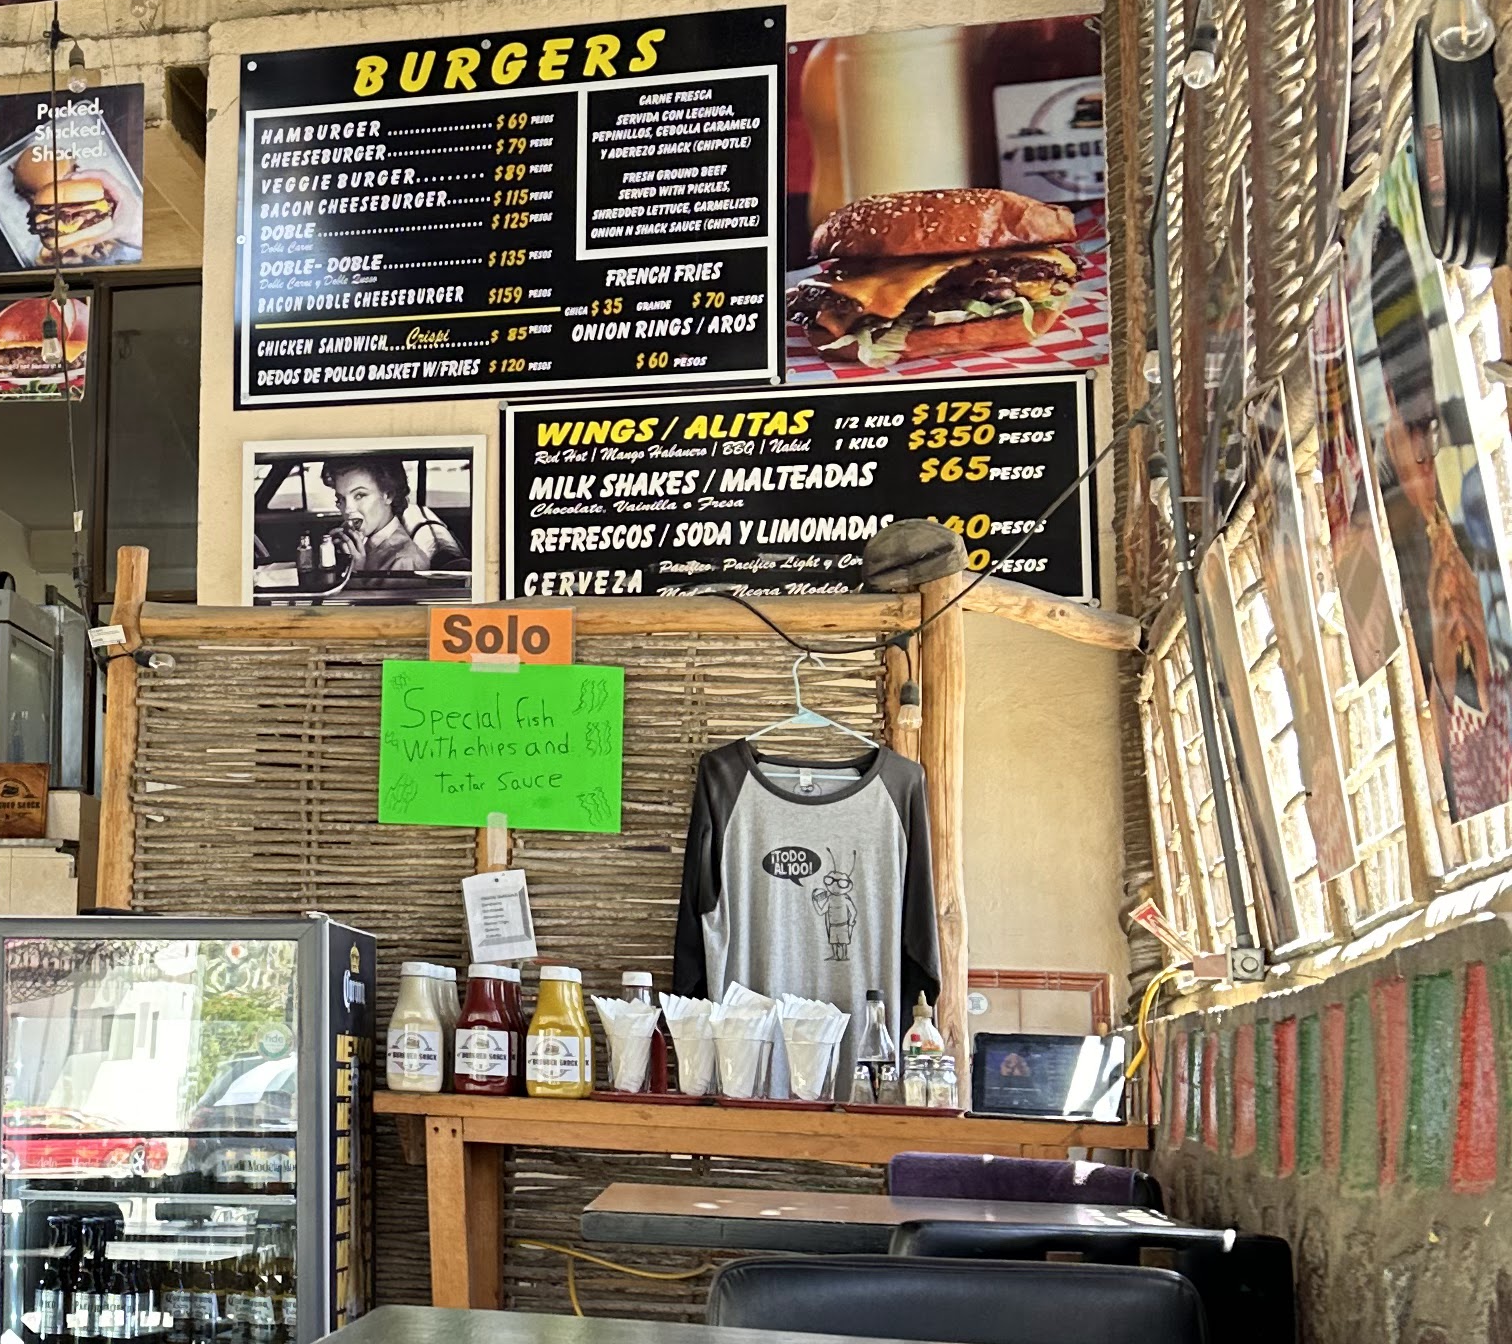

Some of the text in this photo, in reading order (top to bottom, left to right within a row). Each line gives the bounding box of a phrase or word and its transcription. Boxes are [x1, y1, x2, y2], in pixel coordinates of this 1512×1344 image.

[353, 27, 667, 98] BURGERS
[37, 97, 104, 120] Packed.
[639, 89, 712, 106] CARNE FRESCA
[34, 118, 106, 140] Stacked.
[616, 111, 660, 126] SERVIDA
[661, 108, 684, 122] CON
[656, 123, 701, 138] CEBOLLA
[702, 118, 760, 132] CARAMELO
[260, 120, 381, 144] HAMBURGER
[32, 139, 106, 162] Shacked.
[260, 144, 386, 169] CHEESEBURGER
[608, 144, 656, 160] ADEREZO
[656, 142, 692, 155] SHACK
[693, 136, 752, 152] (CHIPOTLE)
[261, 174, 332, 194] VEGGIE
[337, 168, 416, 190] BURGER
[622, 164, 728, 184] FRESH GROUND BEEF
[618, 186, 657, 200] SERVED
[659, 184, 686, 197] WITH
[260, 190, 448, 220] BACON CHEESEBURGER
[592, 206, 644, 220] SHREDDED
[694, 197, 758, 212] CARMELIZED
[260, 222, 316, 241] DOBLE
[590, 214, 760, 239] ONION N SHACK SAUCE (CHIPOTLE)
[326, 254, 384, 273] DOBLE
[606, 262, 724, 288] FRENCH FRIES
[258, 286, 523, 314] BACON DOBLE CHEESEBURGER $159
[636, 300, 672, 312] GRANDE
[730, 294, 764, 306] PESOS
[572, 312, 758, 342] ONION RINGS AROS
[258, 326, 450, 356] CHICKEN SANDWICH Crispi
[258, 358, 481, 386] DEDOS DE POLLO BASKET W/FRIES
[538, 418, 660, 447] WINGS
[684, 409, 815, 440] ALITAS
[834, 416, 859, 430] 1/2
[864, 414, 904, 428] KILO
[998, 406, 1055, 420] PESOS
[534, 424, 1055, 466] Red Hot Mango Habanero BBQ Nakid 1 KILO $350 PESOS
[528, 456, 1046, 501] MILK SHAKES MALTEADAS $65 PESOS
[613, 498, 678, 513] Vainilla
[682, 500, 692, 510] o
[698, 496, 744, 512] Fresa
[530, 524, 656, 554] REFRESCOS
[672, 520, 732, 547] SODA
[738, 520, 754, 545] Y
[990, 519, 1047, 534] PESOS
[722, 556, 776, 572] Pacifico
[780, 554, 820, 569] Light
[524, 569, 642, 597] CERVEZA
[442, 614, 551, 654] Solo
[400, 687, 555, 734] Special fish
[464, 736, 518, 759] chips
[525, 732, 570, 754] and
[435, 771, 486, 794] Tartar
[774, 862, 812, 876] AL 100!
